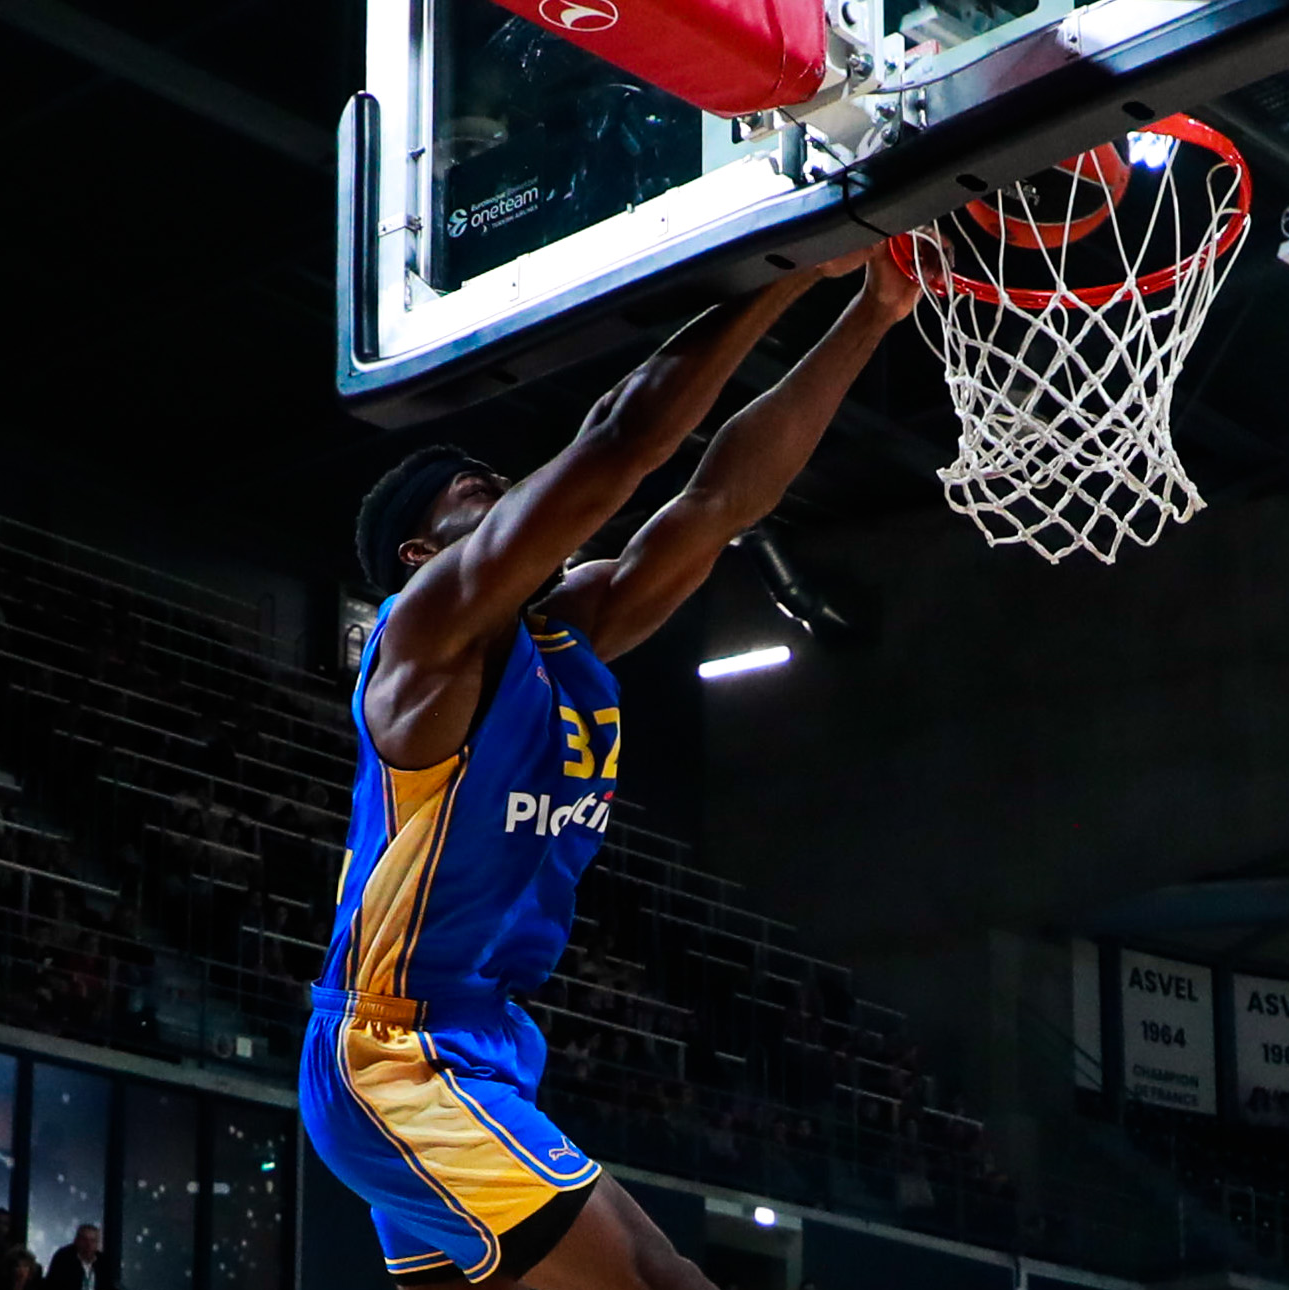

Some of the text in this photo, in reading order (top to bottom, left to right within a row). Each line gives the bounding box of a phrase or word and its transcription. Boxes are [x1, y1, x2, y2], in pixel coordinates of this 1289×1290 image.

[471, 187, 539, 227] oneteam
[1128, 967, 1198, 1001] ASVEL
[1141, 1020, 1186, 1048] 1964
